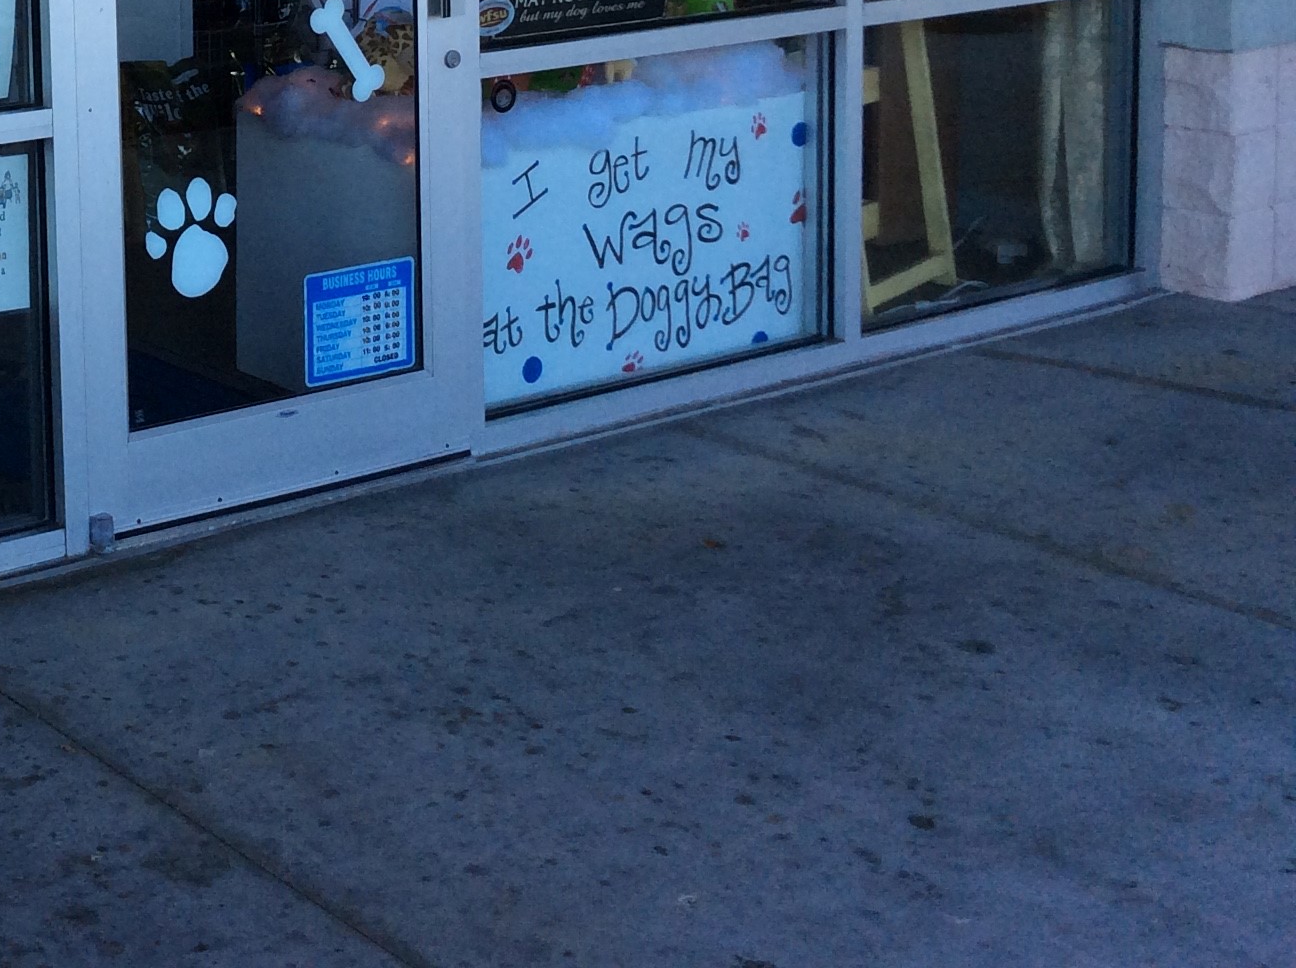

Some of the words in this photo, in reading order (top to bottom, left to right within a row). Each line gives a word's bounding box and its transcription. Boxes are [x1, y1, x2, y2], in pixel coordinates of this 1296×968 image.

[520, 10, 538, 23] but
[542, 10, 563, 23] my
[566, 3, 589, 19] dog
[592, 0, 623, 13] loves
[626, 0, 645, 9] me
[185, 83, 210, 100] the
[512, 160, 548, 219] I
[588, 136, 649, 208] get
[583, 203, 723, 276] Wags
[1, 267, 6, 276] a
[322, 271, 364, 291] BUSINESS
[368, 266, 397, 282] HOURS
[536, 280, 594, 347] the
[606, 275, 722, 352] Doggy
[316, 343, 339, 353] FRIDAY
[316, 352, 351, 363] SATURDAY
[374, 352, 399, 364] CLOSED
